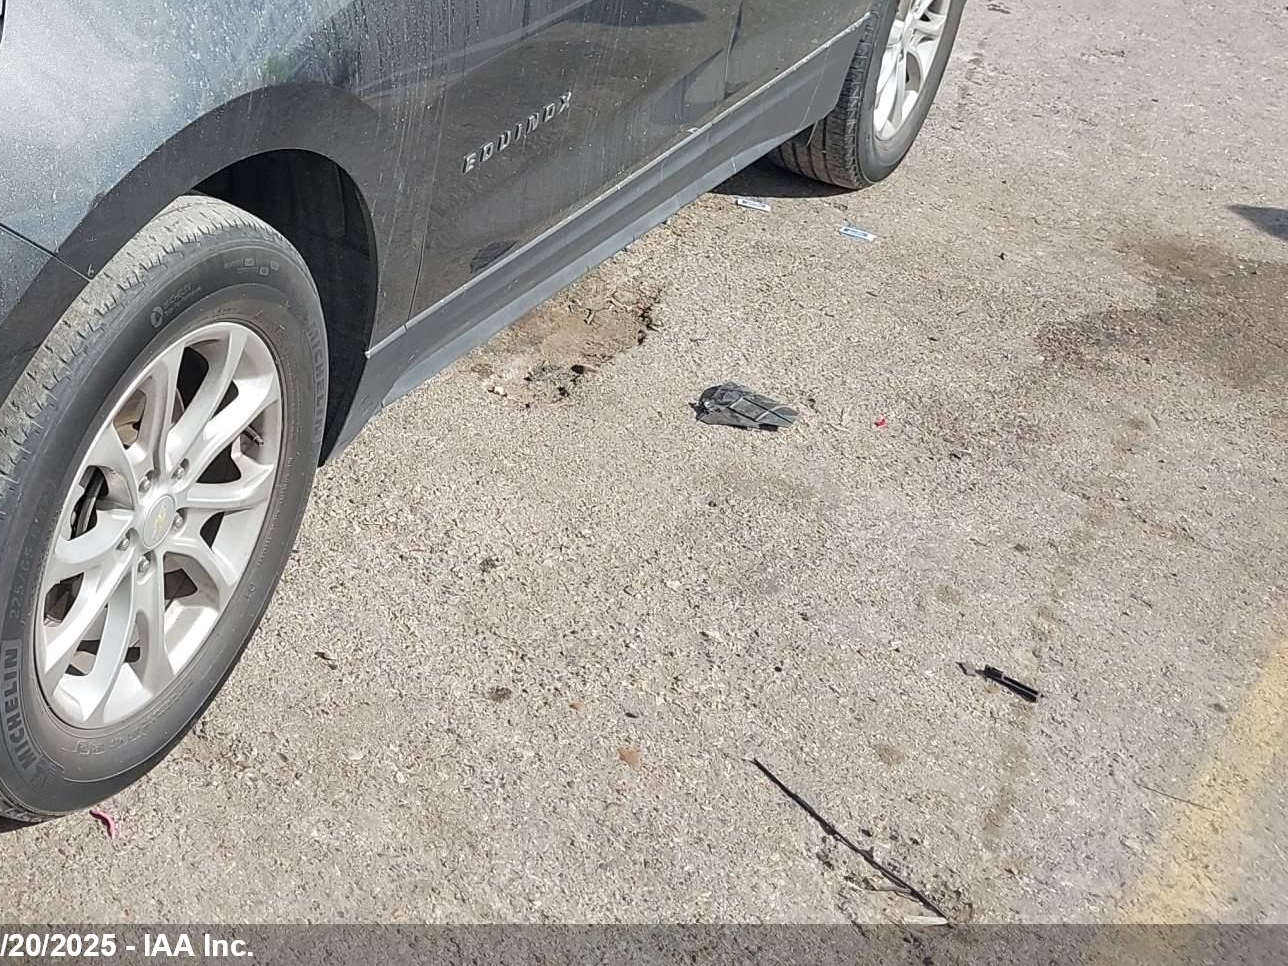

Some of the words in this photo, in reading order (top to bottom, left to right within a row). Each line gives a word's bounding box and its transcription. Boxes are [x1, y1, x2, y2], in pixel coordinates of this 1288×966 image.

[462, 90, 572, 174] EQUINOX
[309, 327, 325, 435] MICHELIN
[3, 647, 38, 770] MICHELIN
